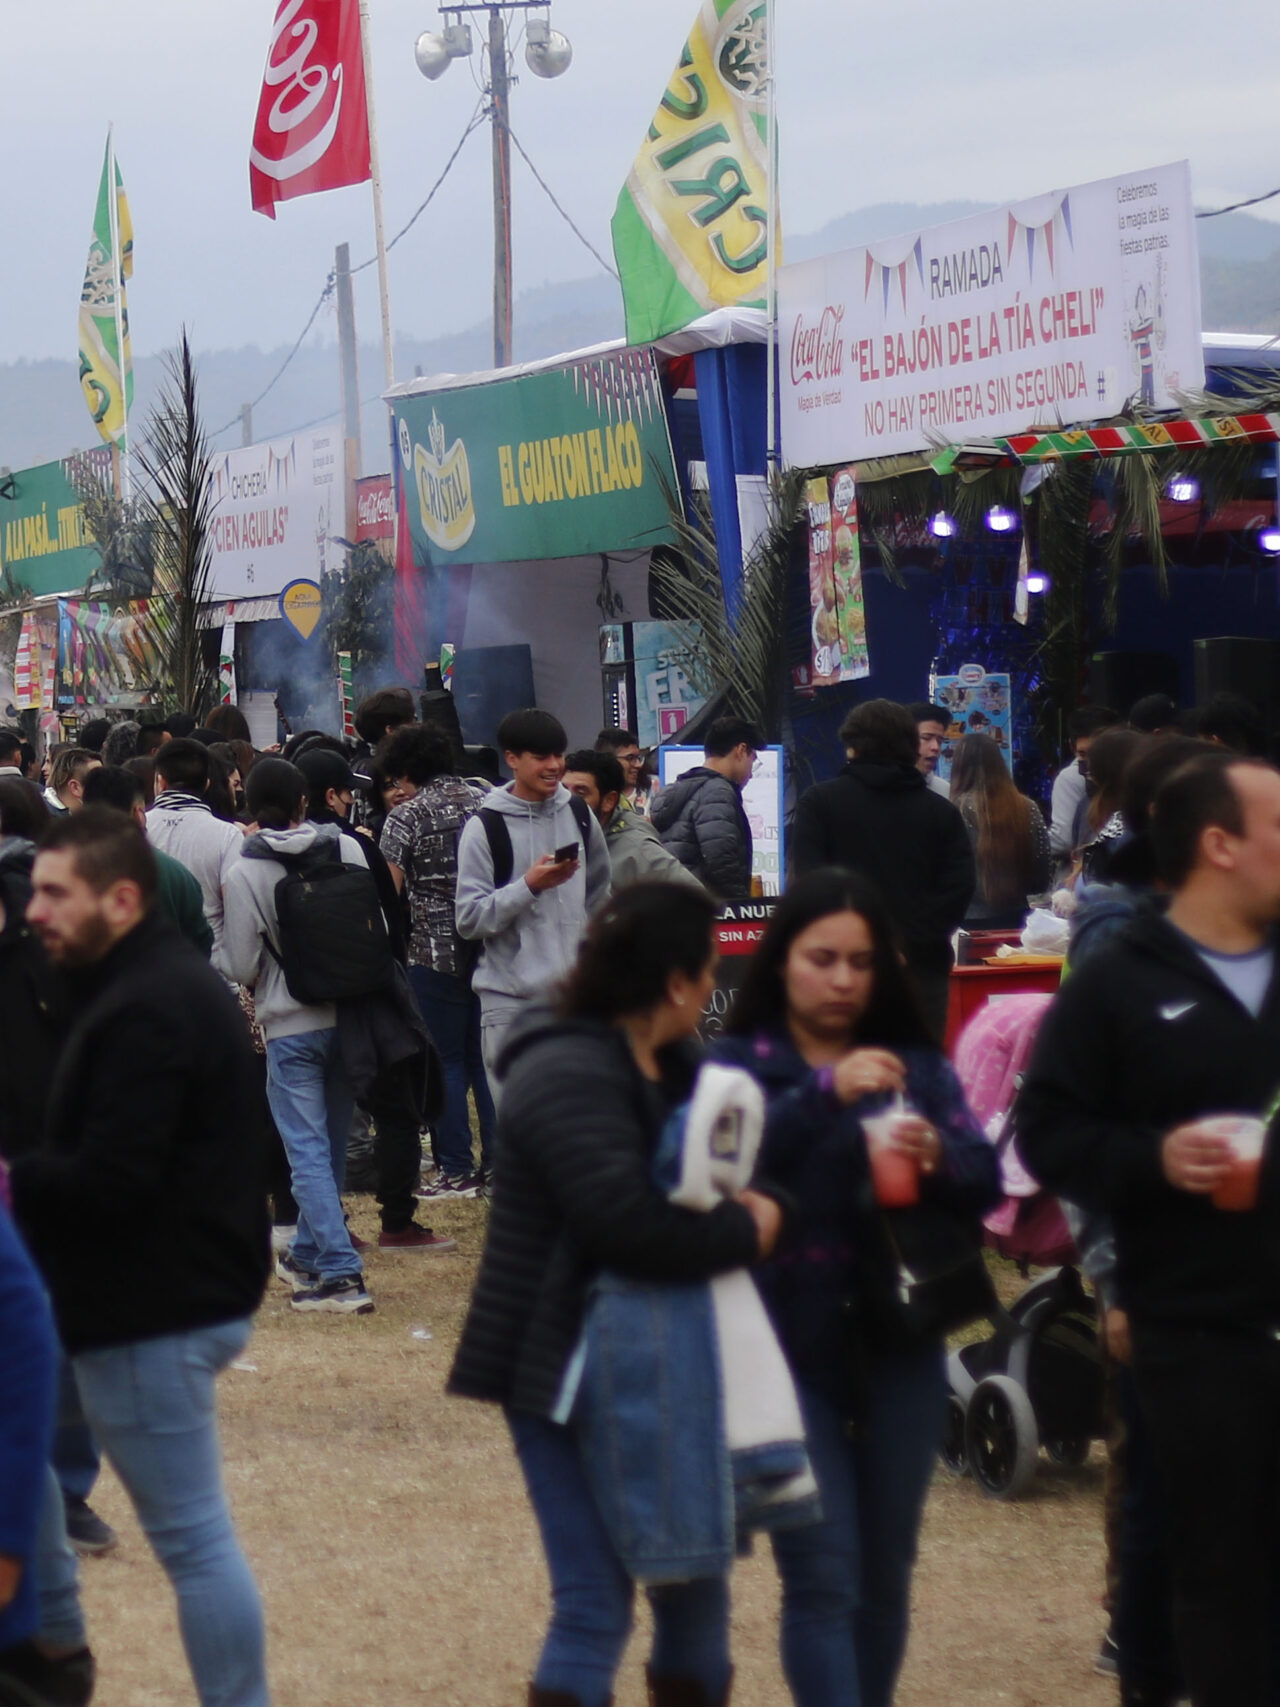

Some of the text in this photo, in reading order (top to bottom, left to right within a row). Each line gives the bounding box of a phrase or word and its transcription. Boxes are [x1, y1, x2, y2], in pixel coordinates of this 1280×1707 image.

[1126, 210, 1148, 231] magia
[929, 241, 1003, 300] RAMADA
[883, 314, 943, 377] BAJÓN
[948, 316, 973, 367] DE
[976, 312, 1001, 361] LA
[1003, 291, 1036, 352] TÍA
[864, 400, 884, 437] NO
[887, 393, 916, 430] HAY
[918, 378, 985, 428] PRIMERA
[986, 374, 1015, 416] SIN
[1016, 360, 1088, 411] SEGUNDA
[420, 463, 468, 524] CRISTAL
[498, 420, 643, 507] EL GUATON FLACO
[720, 930, 743, 942] SIN
